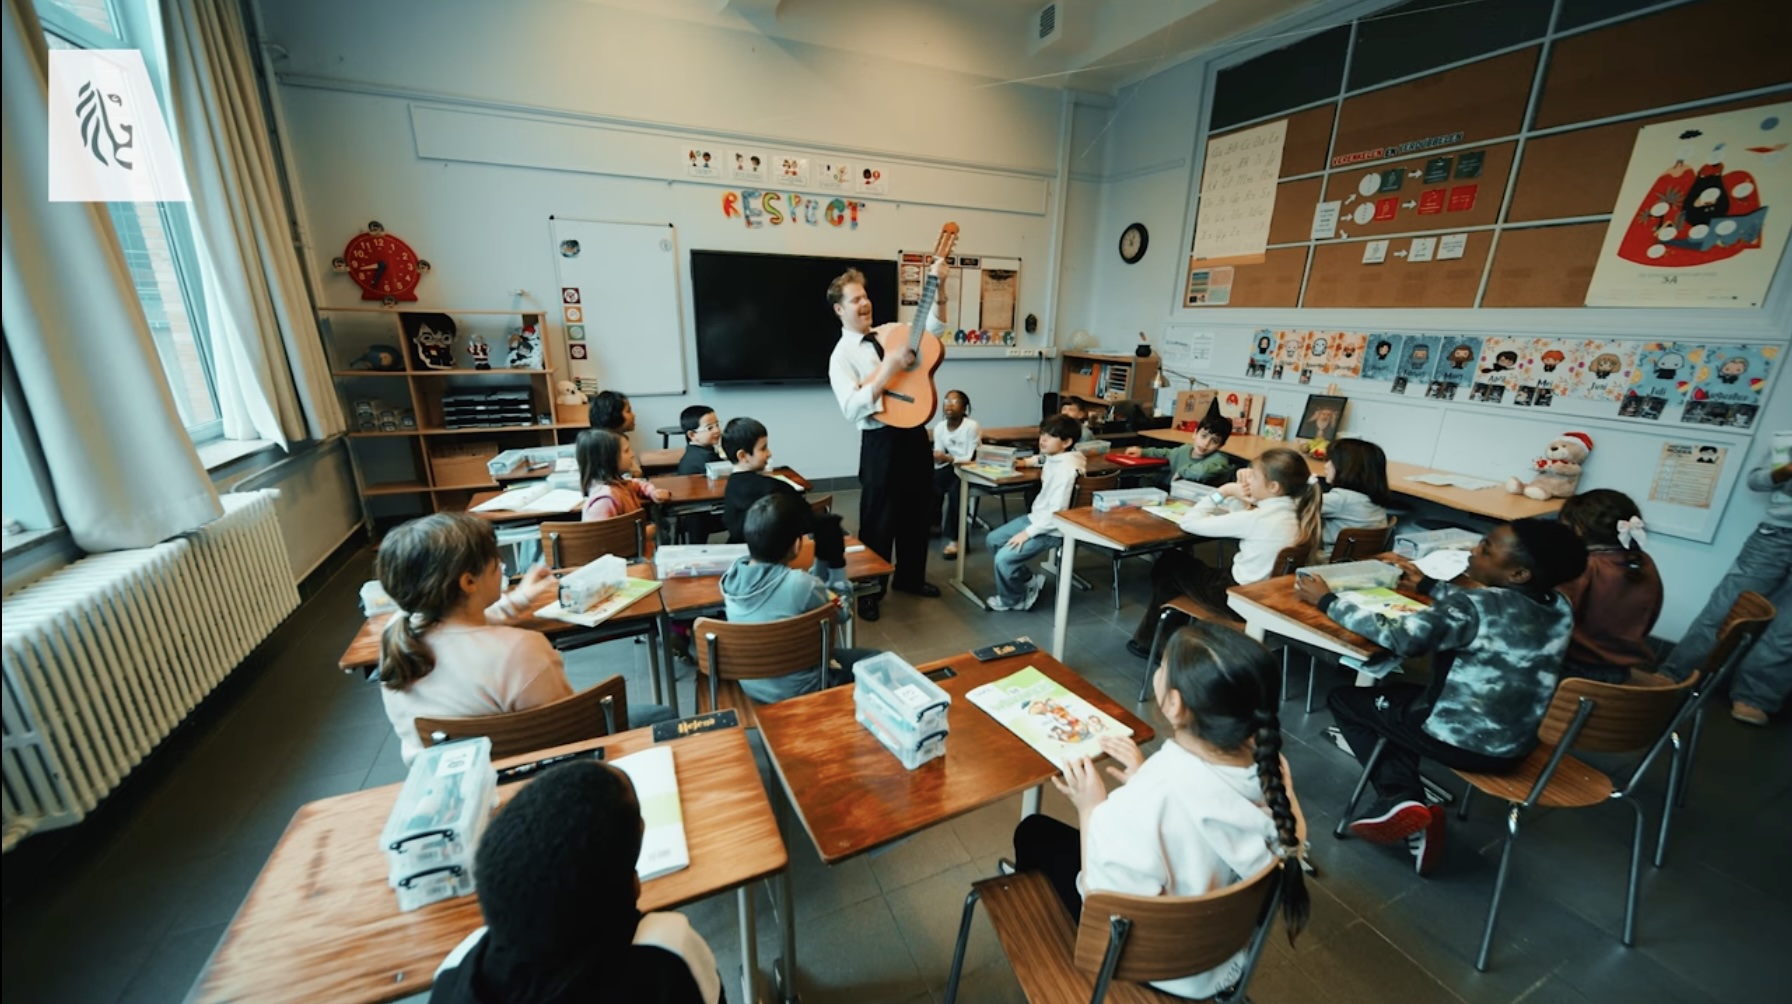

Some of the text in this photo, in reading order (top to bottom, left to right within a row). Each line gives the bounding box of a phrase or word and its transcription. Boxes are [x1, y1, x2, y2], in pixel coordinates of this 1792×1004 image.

[722, 190, 866, 230] RESPECT
[360, 242, 371, 250] 11
[373, 239, 384, 247] 12
[390, 243, 396, 251] 1
[353, 250, 364, 258] 10
[402, 252, 408, 260] 2
[351, 260, 358, 268] 9
[407, 263, 414, 271] 3
[359, 272, 366, 280] 8
[384, 283, 391, 292] 6
[1590, 382, 1608, 390] Juni
[1650, 386, 1667, 396] Juli
